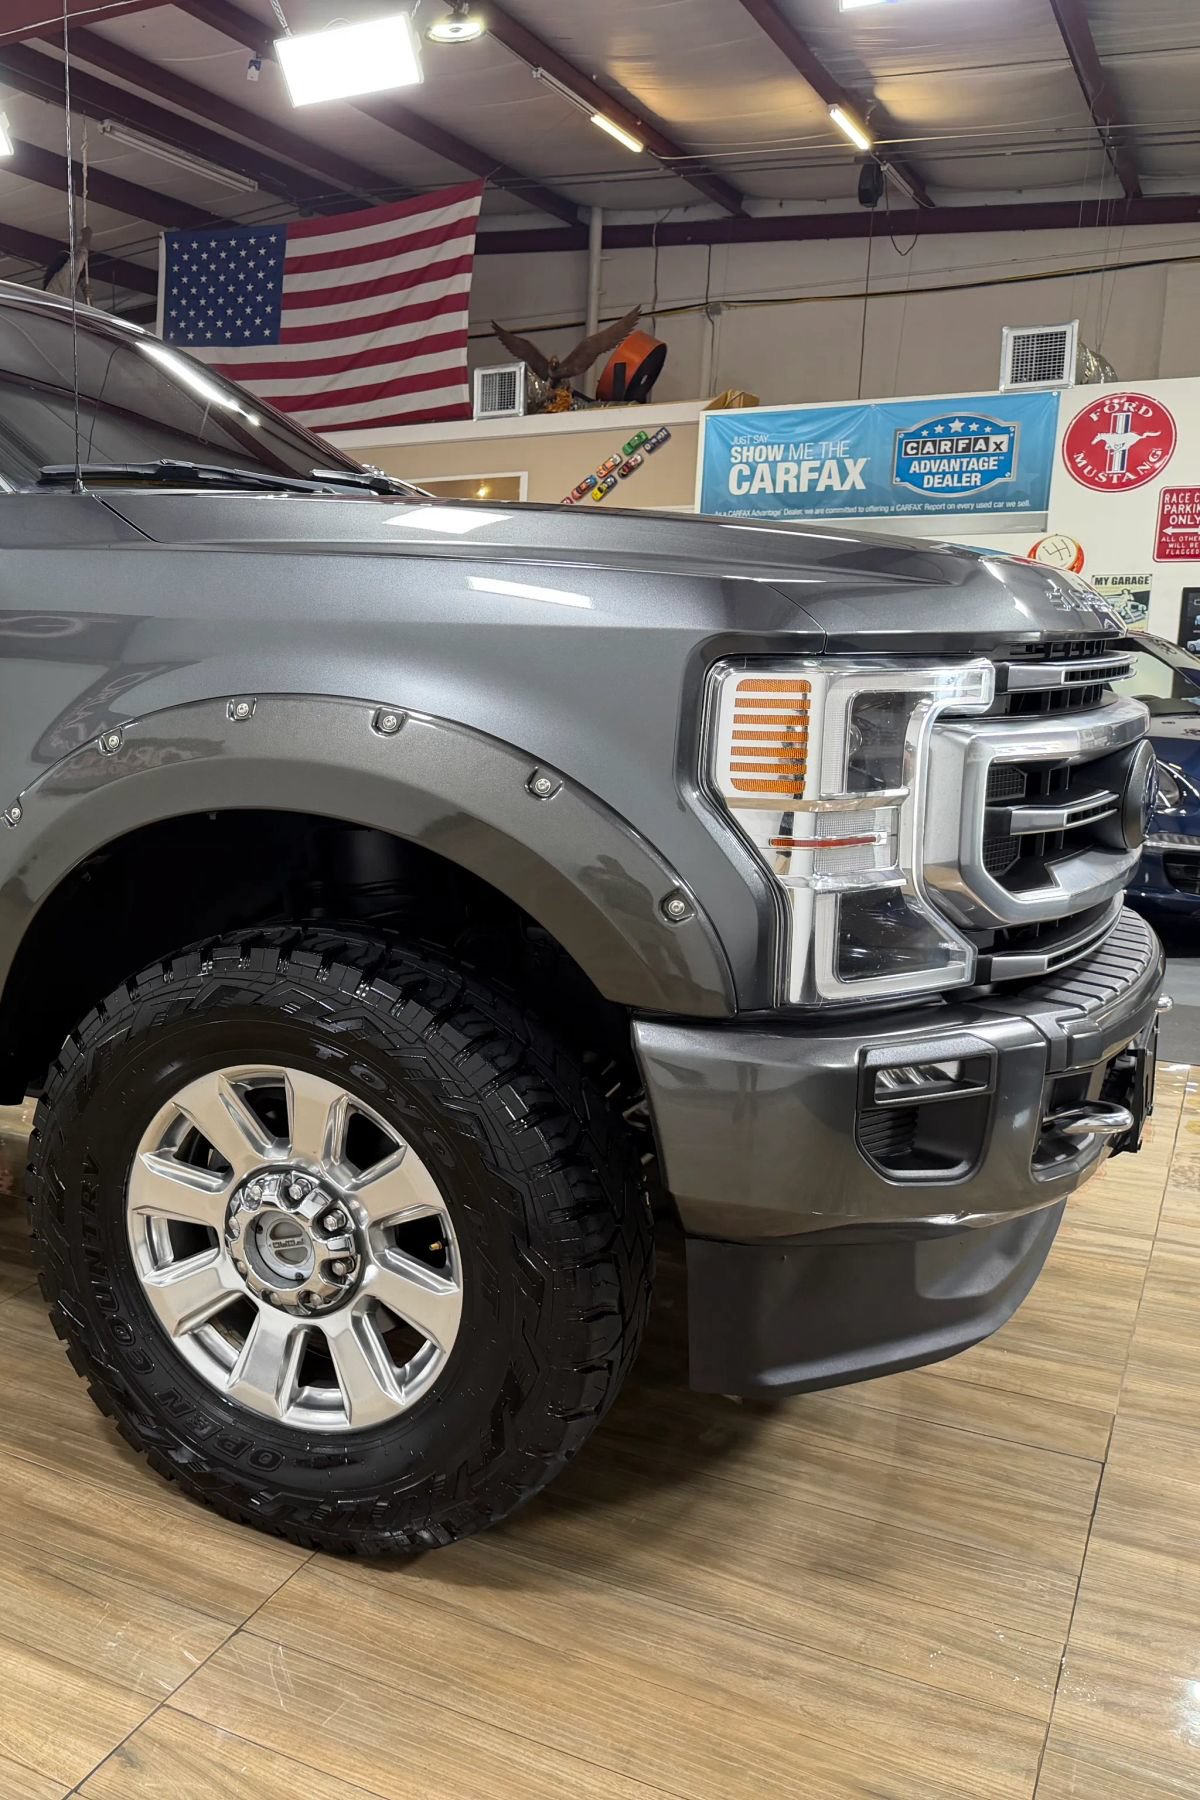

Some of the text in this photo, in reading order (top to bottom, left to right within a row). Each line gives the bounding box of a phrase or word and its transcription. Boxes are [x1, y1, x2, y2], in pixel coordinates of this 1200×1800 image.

[1089, 401, 1153, 422] FORD
[732, 434, 769, 445] JUST SAY
[906, 438, 1005, 455] CARFAX
[730, 440, 850, 463] SHOW ME THE
[1073, 448, 1163, 484] MUSTANG
[728, 457, 868, 495] CARFAX
[923, 473, 982, 488] DEALER
[1164, 492, 1191, 503] RACE
[825, 506, 857, 514] committed
[858, 506, 865, 514] to
[865, 505, 889, 514] offering
[924, 503, 946, 512] Report
[957, 503, 974, 511] every
[975, 501, 992, 509] used
[1017, 499, 1031, 508] sell.
[1169, 515, 1200, 525] ONLY
[1094, 576, 1150, 586] MY GARAGE
[309, 1037, 457, 1168] TOYO
[80, 1152, 285, 1472] OPEN COUNTRY
